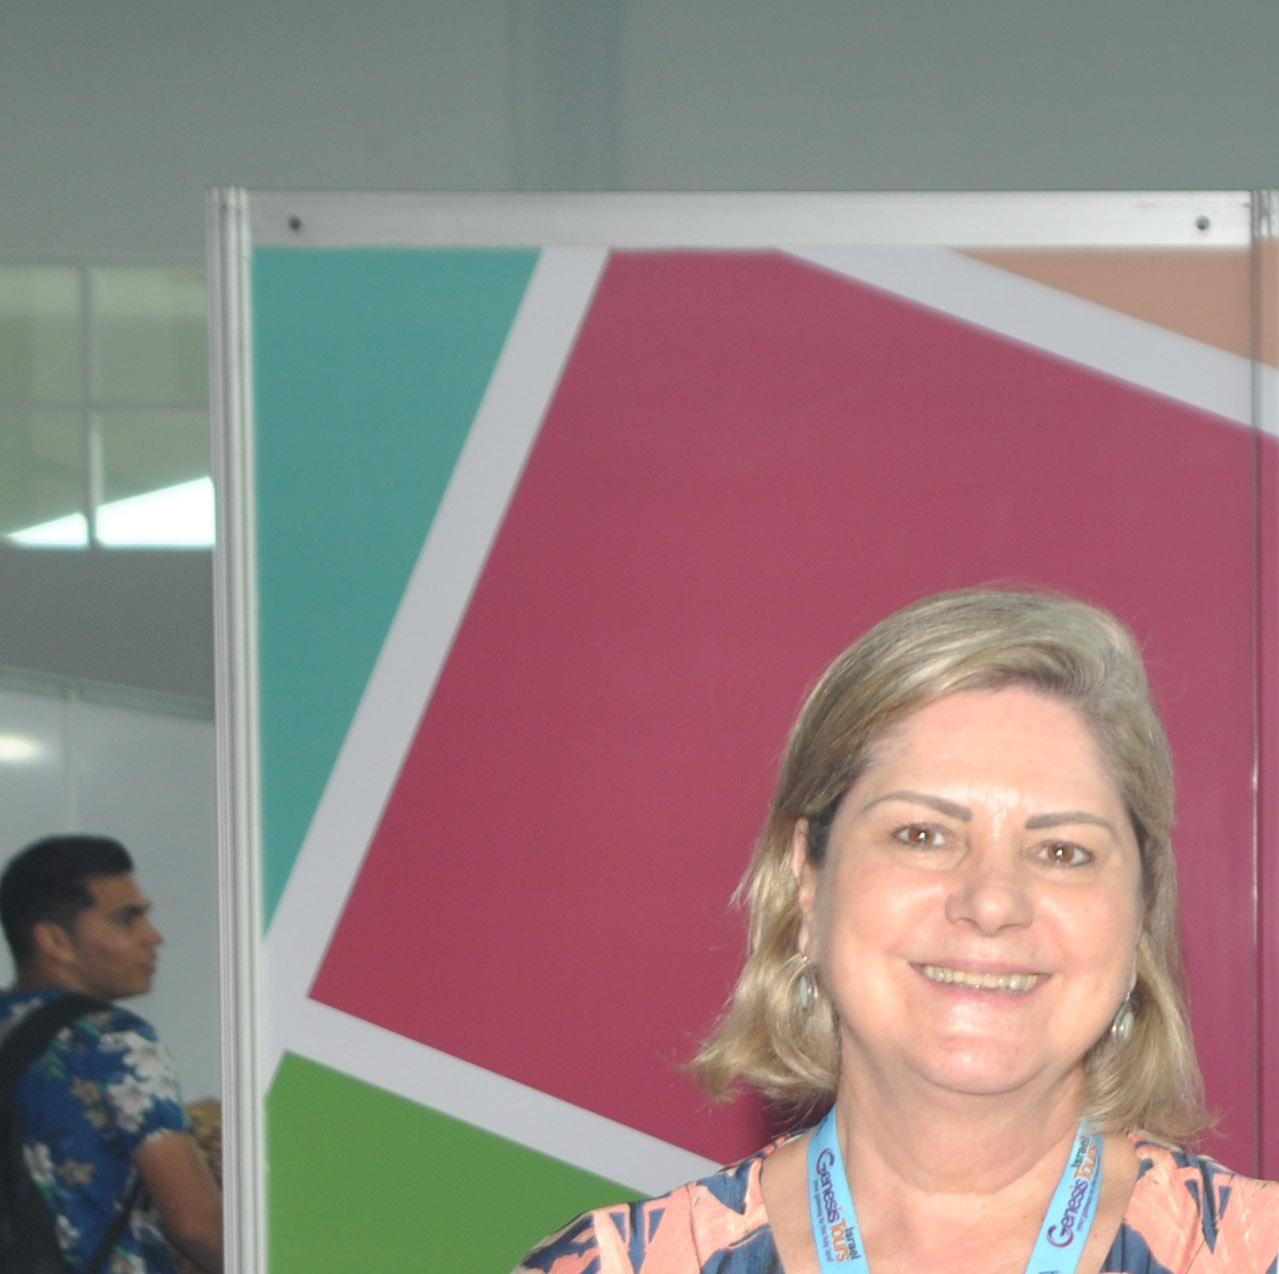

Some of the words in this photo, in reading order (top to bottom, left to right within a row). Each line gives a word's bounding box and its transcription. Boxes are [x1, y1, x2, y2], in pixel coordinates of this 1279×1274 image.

[1068, 1135, 1090, 1167] Israel
[815, 1146, 843, 1223] Genesis
[829, 1217, 852, 1263] Tours
[1046, 1178, 1089, 1247] Genesis
[844, 1224, 861, 1259] Israel
